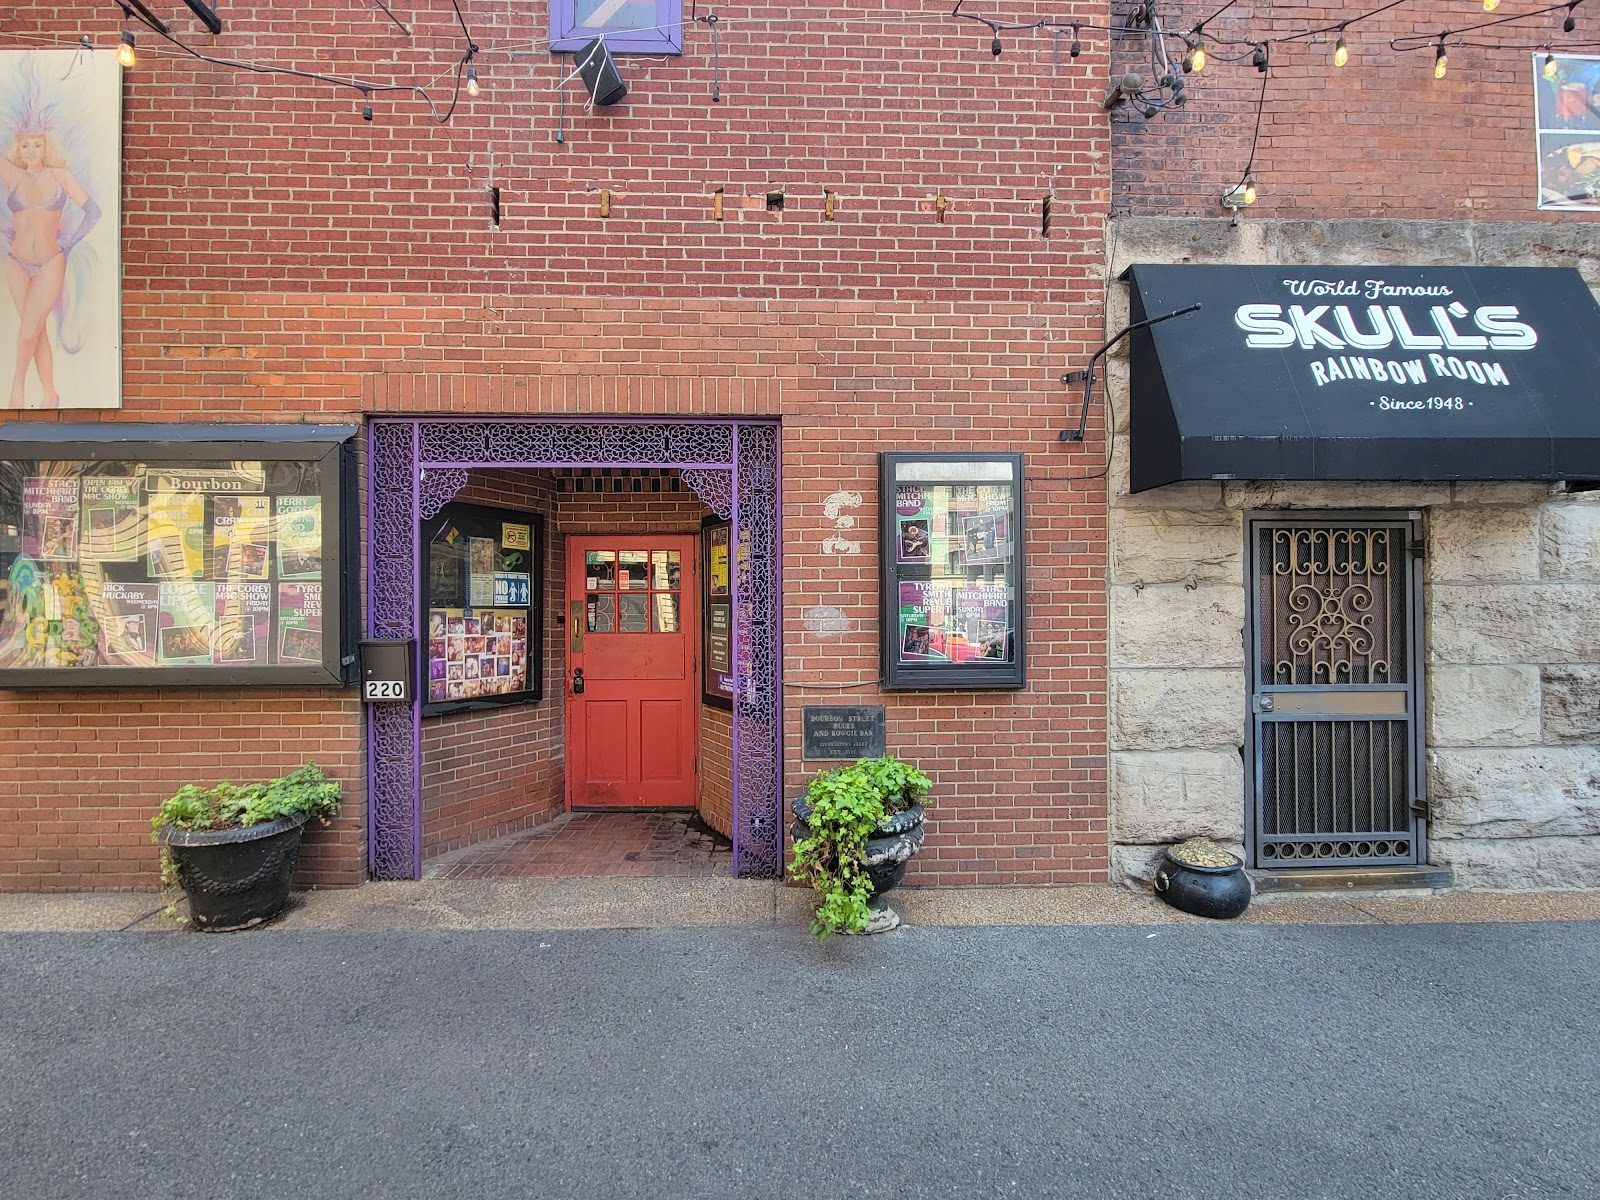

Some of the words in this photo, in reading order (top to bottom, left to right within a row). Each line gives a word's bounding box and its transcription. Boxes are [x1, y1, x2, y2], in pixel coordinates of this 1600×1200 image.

[1283, 279, 1360, 297] World
[1365, 279, 1453, 300] Famous
[1235, 301, 1538, 350] SKULL'S
[1310, 356, 1427, 387] RAINBOW
[1429, 353, 1510, 386] ROOM
[1378, 396, 1426, 410] Since
[1427, 397, 1464, 410] 1948
[48, 480, 78, 488] STACY
[171, 478, 242, 490] Bourbon
[23, 487, 78, 495] MITCHHART
[52, 495, 77, 503] BAND
[896, 492, 948, 500] MITCHH
[957, 494, 977, 502] MAC
[279, 498, 308, 506] TERRY
[103, 584, 125, 592] RICK
[216, 584, 235, 593] THE
[237, 584, 269, 593] COREY
[495, 580, 508, 595] NO
[914, 582, 952, 591] TYRONE
[102, 591, 145, 600] HUCKABY
[215, 592, 236, 600] MAC
[240, 592, 269, 600] SHOW
[923, 590, 952, 598] SMITH
[957, 592, 1008, 600] MITCHHART
[913, 606, 942, 614] SUPER
[369, 682, 402, 697] 220
